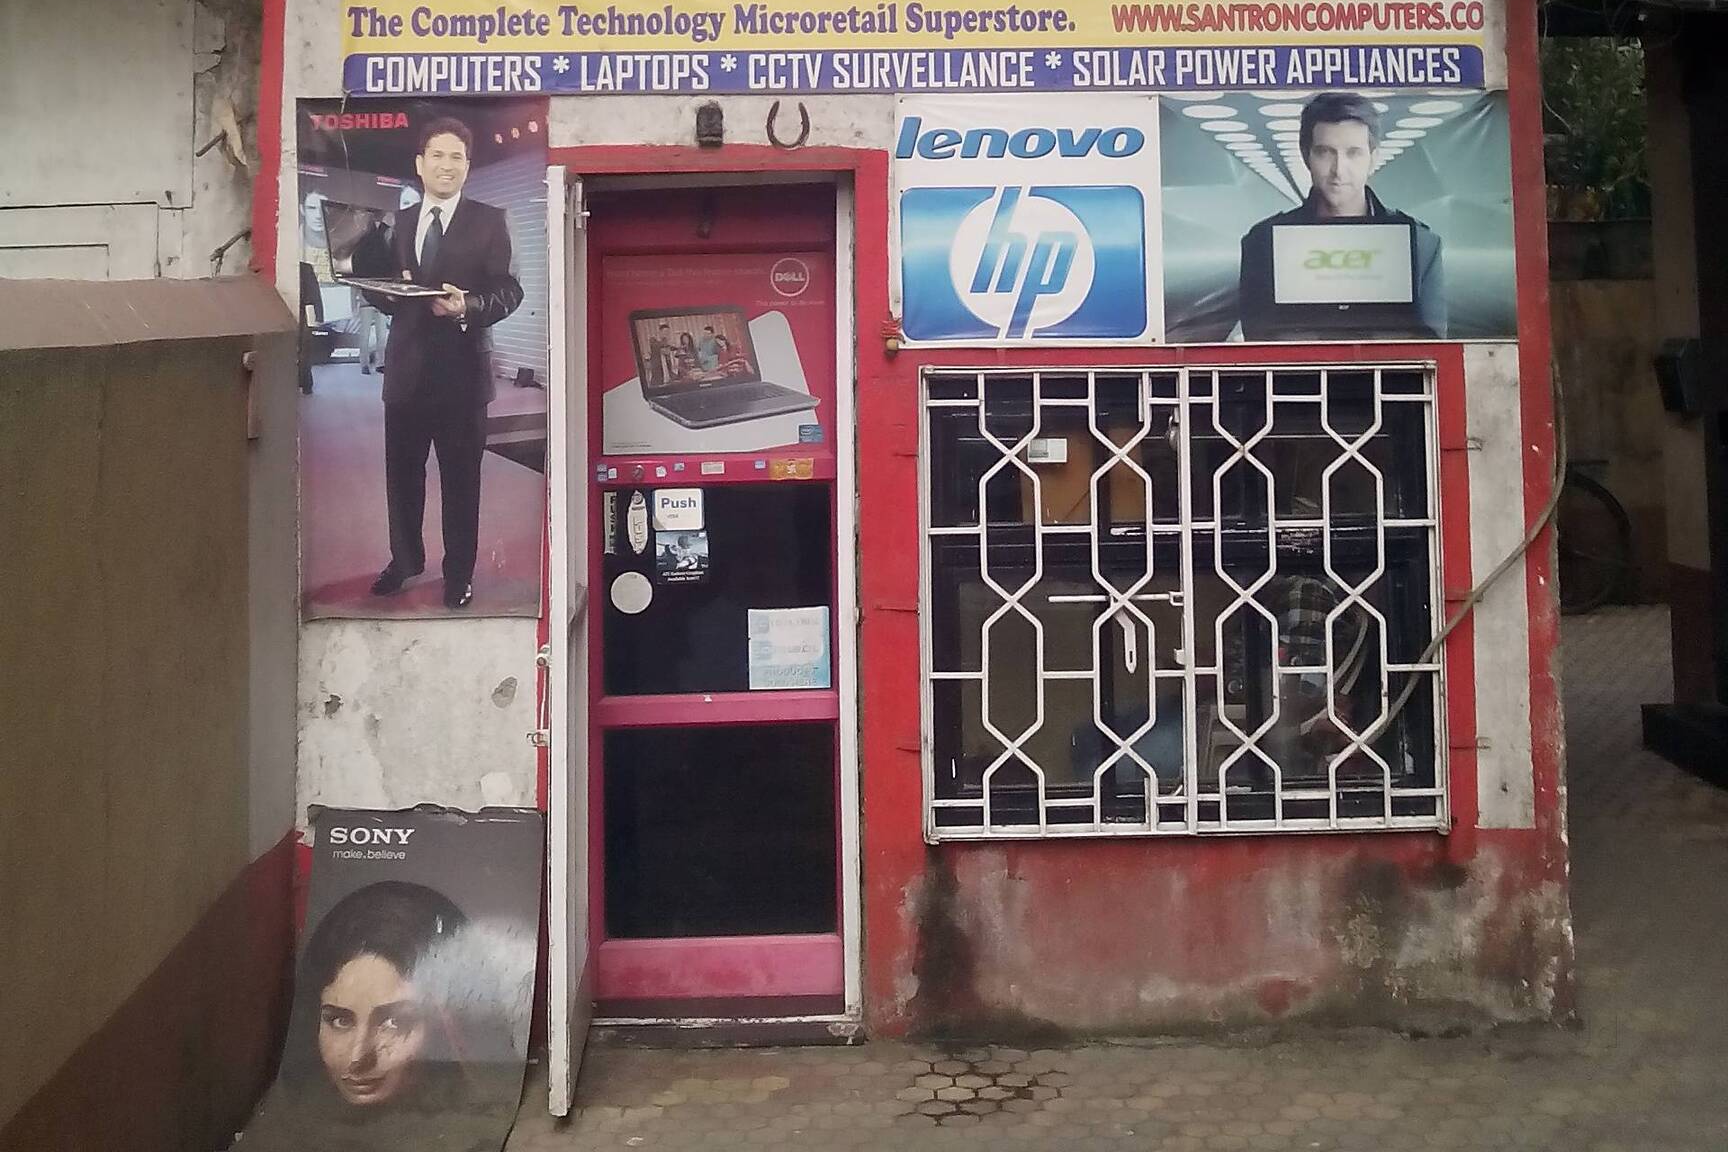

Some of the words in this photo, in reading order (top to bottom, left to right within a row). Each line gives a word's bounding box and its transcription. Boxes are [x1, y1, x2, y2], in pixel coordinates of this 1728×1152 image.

[348, 6, 403, 38] The
[411, 6, 551, 44] Complete
[558, 3, 725, 43] Technology
[734, 2, 898, 35] Microretail
[905, 2, 1076, 39] Superstore.
[366, 54, 543, 93] COMPUTERS
[580, 54, 709, 91] LAPTOPS
[748, 53, 823, 90] CCTV
[834, 51, 1035, 90] SURVELLANCE
[1072, 50, 1166, 87] SOLAR
[1175, 49, 1276, 85] POWER
[1286, 47, 1461, 85] APPLIANCES
[310, 112, 409, 130] TOSHIBA
[895, 116, 1146, 160] lenovo
[970, 185, 1079, 339] hp
[1302, 249, 1382, 270] acer
[774, 272, 806, 283] DELL
[661, 496, 697, 509] Push
[330, 827, 415, 845] SONY
[332, 848, 406, 860] make.believe
